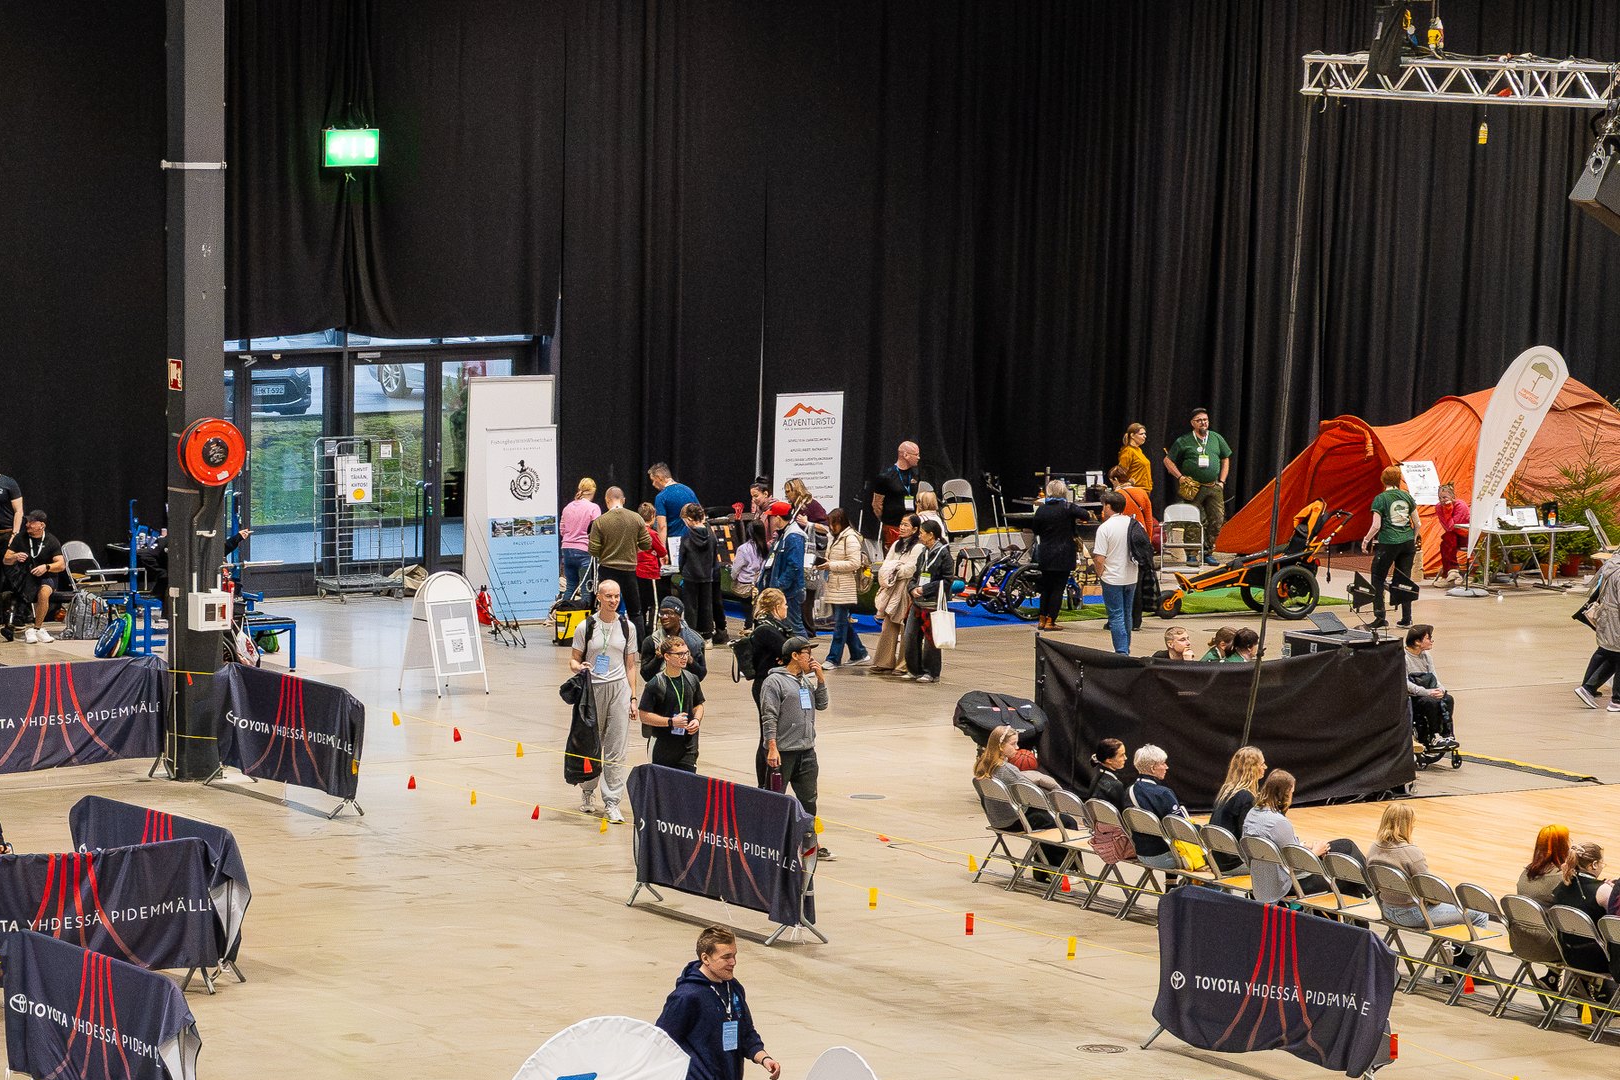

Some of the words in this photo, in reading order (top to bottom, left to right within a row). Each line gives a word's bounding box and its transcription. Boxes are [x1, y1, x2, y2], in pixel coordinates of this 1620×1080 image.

[782, 416, 836, 427] ADVENTURISTO
[20, 710, 81, 727] YHDESSÄ
[233, 716, 270, 734] TOYOTA
[272, 724, 305, 741] YHDESSÄ
[656, 819, 694, 840] TOYOTA
[696, 829, 740, 852] YHDESSÄ
[26, 908, 102, 932] YHDESSÄ
[110, 896, 213, 923] PIDEMMÄLLE
[1195, 975, 1241, 995] TOYOTA
[1244, 981, 1300, 1003] YHDESSÄ
[27, 1000, 68, 1029] TOYOTA
[71, 1015, 118, 1046] YHDESSÄ
